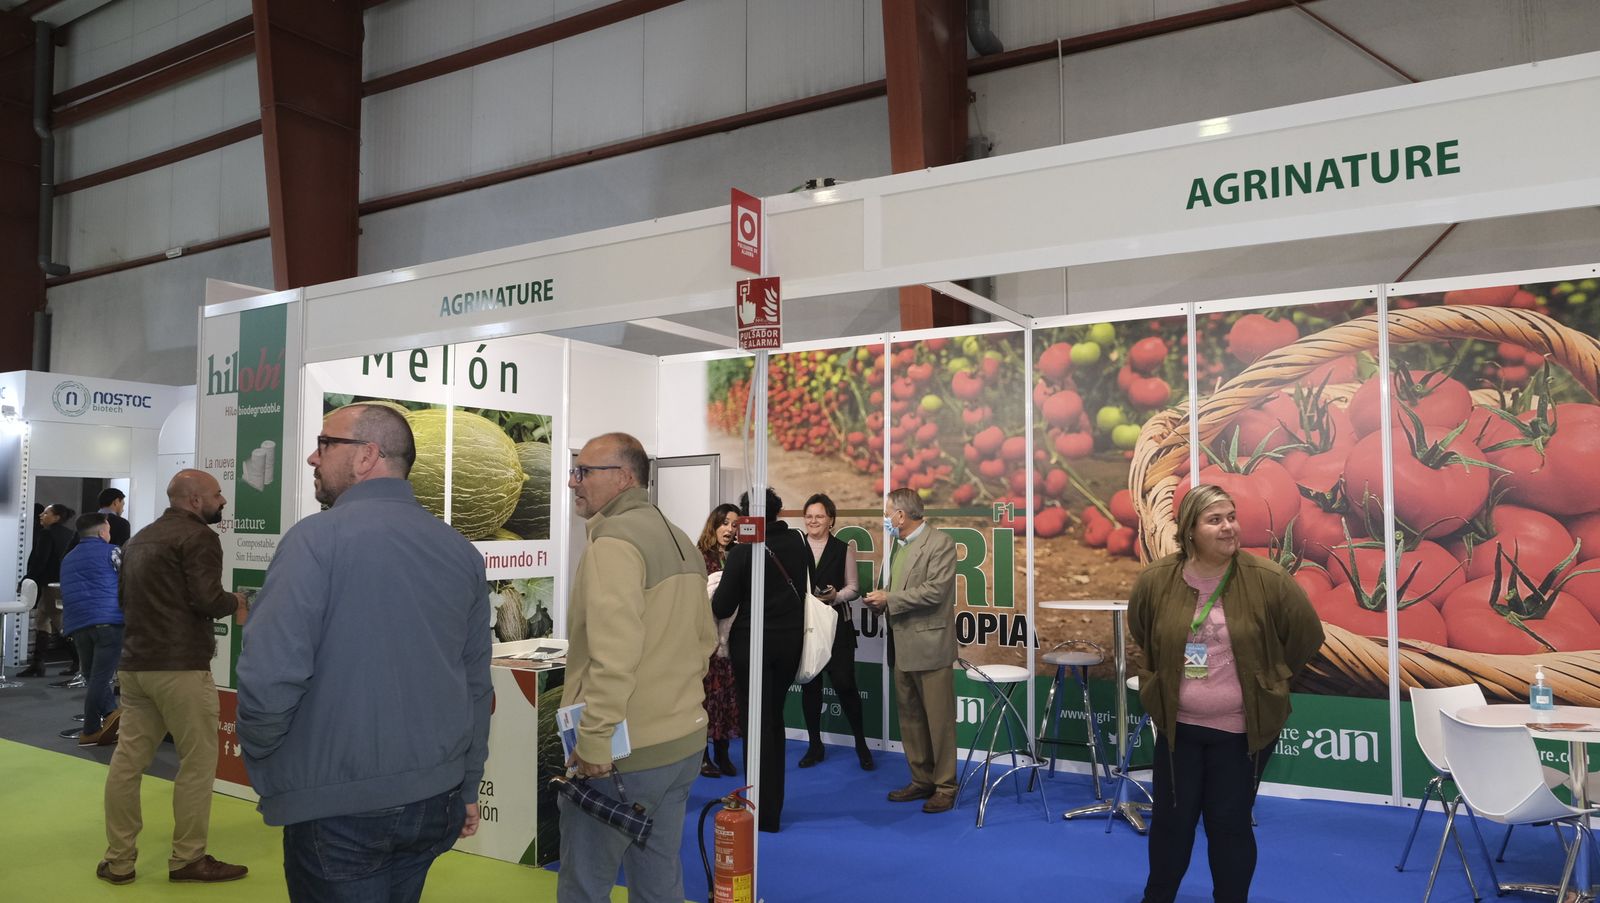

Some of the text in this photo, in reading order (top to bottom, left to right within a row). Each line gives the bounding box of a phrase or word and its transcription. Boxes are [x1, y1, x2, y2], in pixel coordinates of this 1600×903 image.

[1186, 139, 1460, 210] AGRINATURE
[440, 279, 554, 317] AGRINATURE
[740, 329, 778, 340] PULSADOR
[748, 338, 778, 348] ALARMA
[362, 343, 518, 394] Melón
[92, 403, 123, 413] biotech
[205, 458, 235, 468] La nueva
[223, 471, 234, 480] era
[993, 502, 1015, 522] F1
[216, 513, 266, 534] agrinature
[246, 551, 273, 563] Humeda
[485, 551, 547, 568] imundo F1
[955, 611, 1040, 649] OPIA
